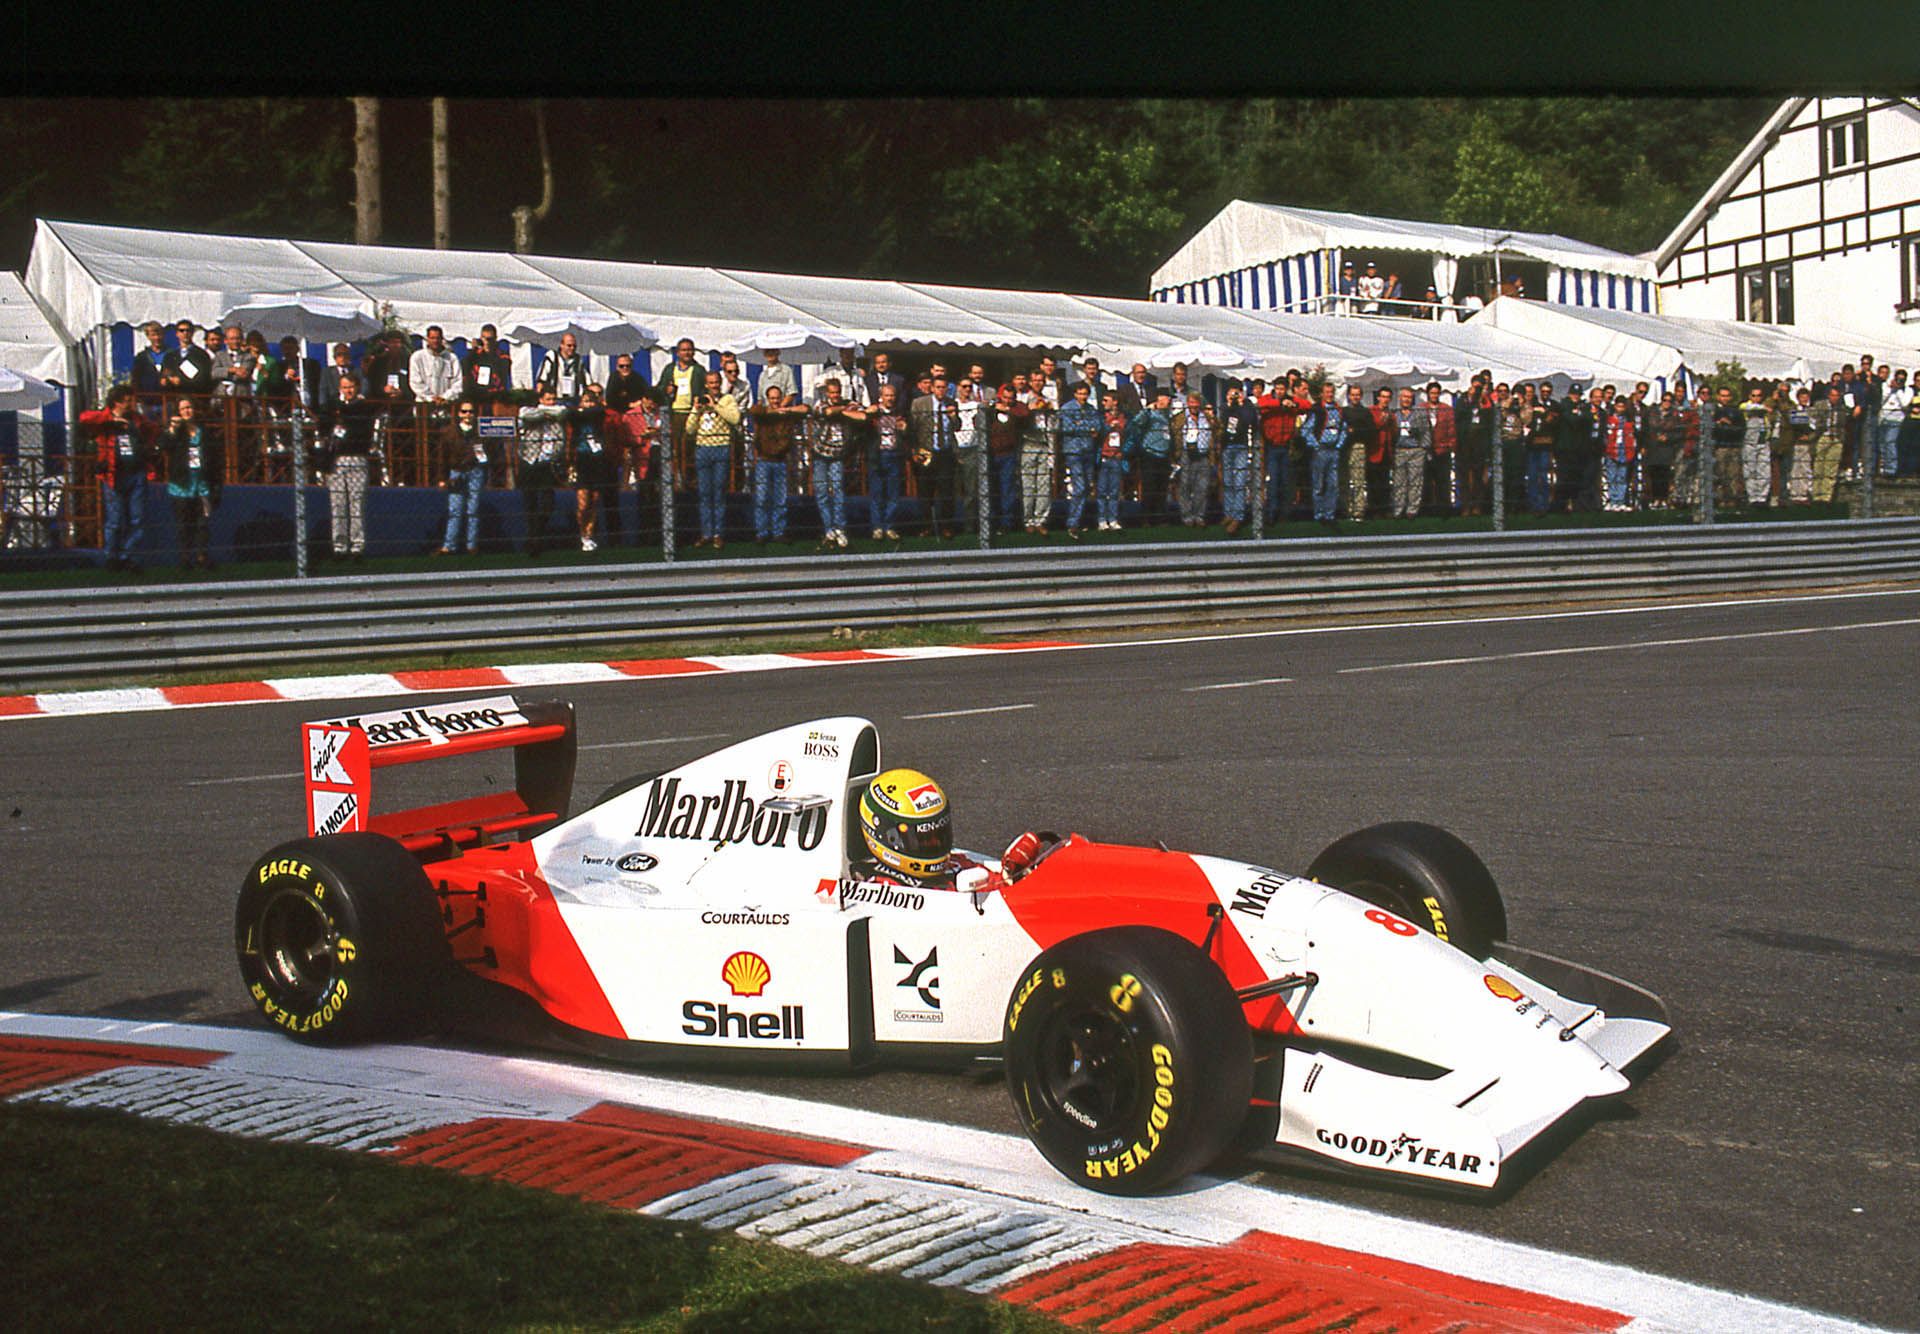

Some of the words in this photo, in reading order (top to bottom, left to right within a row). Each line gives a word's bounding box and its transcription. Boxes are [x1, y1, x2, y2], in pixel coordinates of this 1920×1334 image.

[804, 742, 839, 758] BOSS
[635, 777, 828, 851] Marlboro
[259, 859, 312, 884] EAGLE
[622, 855, 653, 870] Ford
[840, 881, 925, 911] Marlboro
[701, 911, 791, 925] COURTAULDS
[1364, 909, 1419, 937] 8
[251, 978, 349, 1033] GOODYEAR
[1008, 968, 1045, 1032] EAGLE
[682, 1000, 804, 1041] Shell
[1084, 1043, 1175, 1179] GOODYEAR
